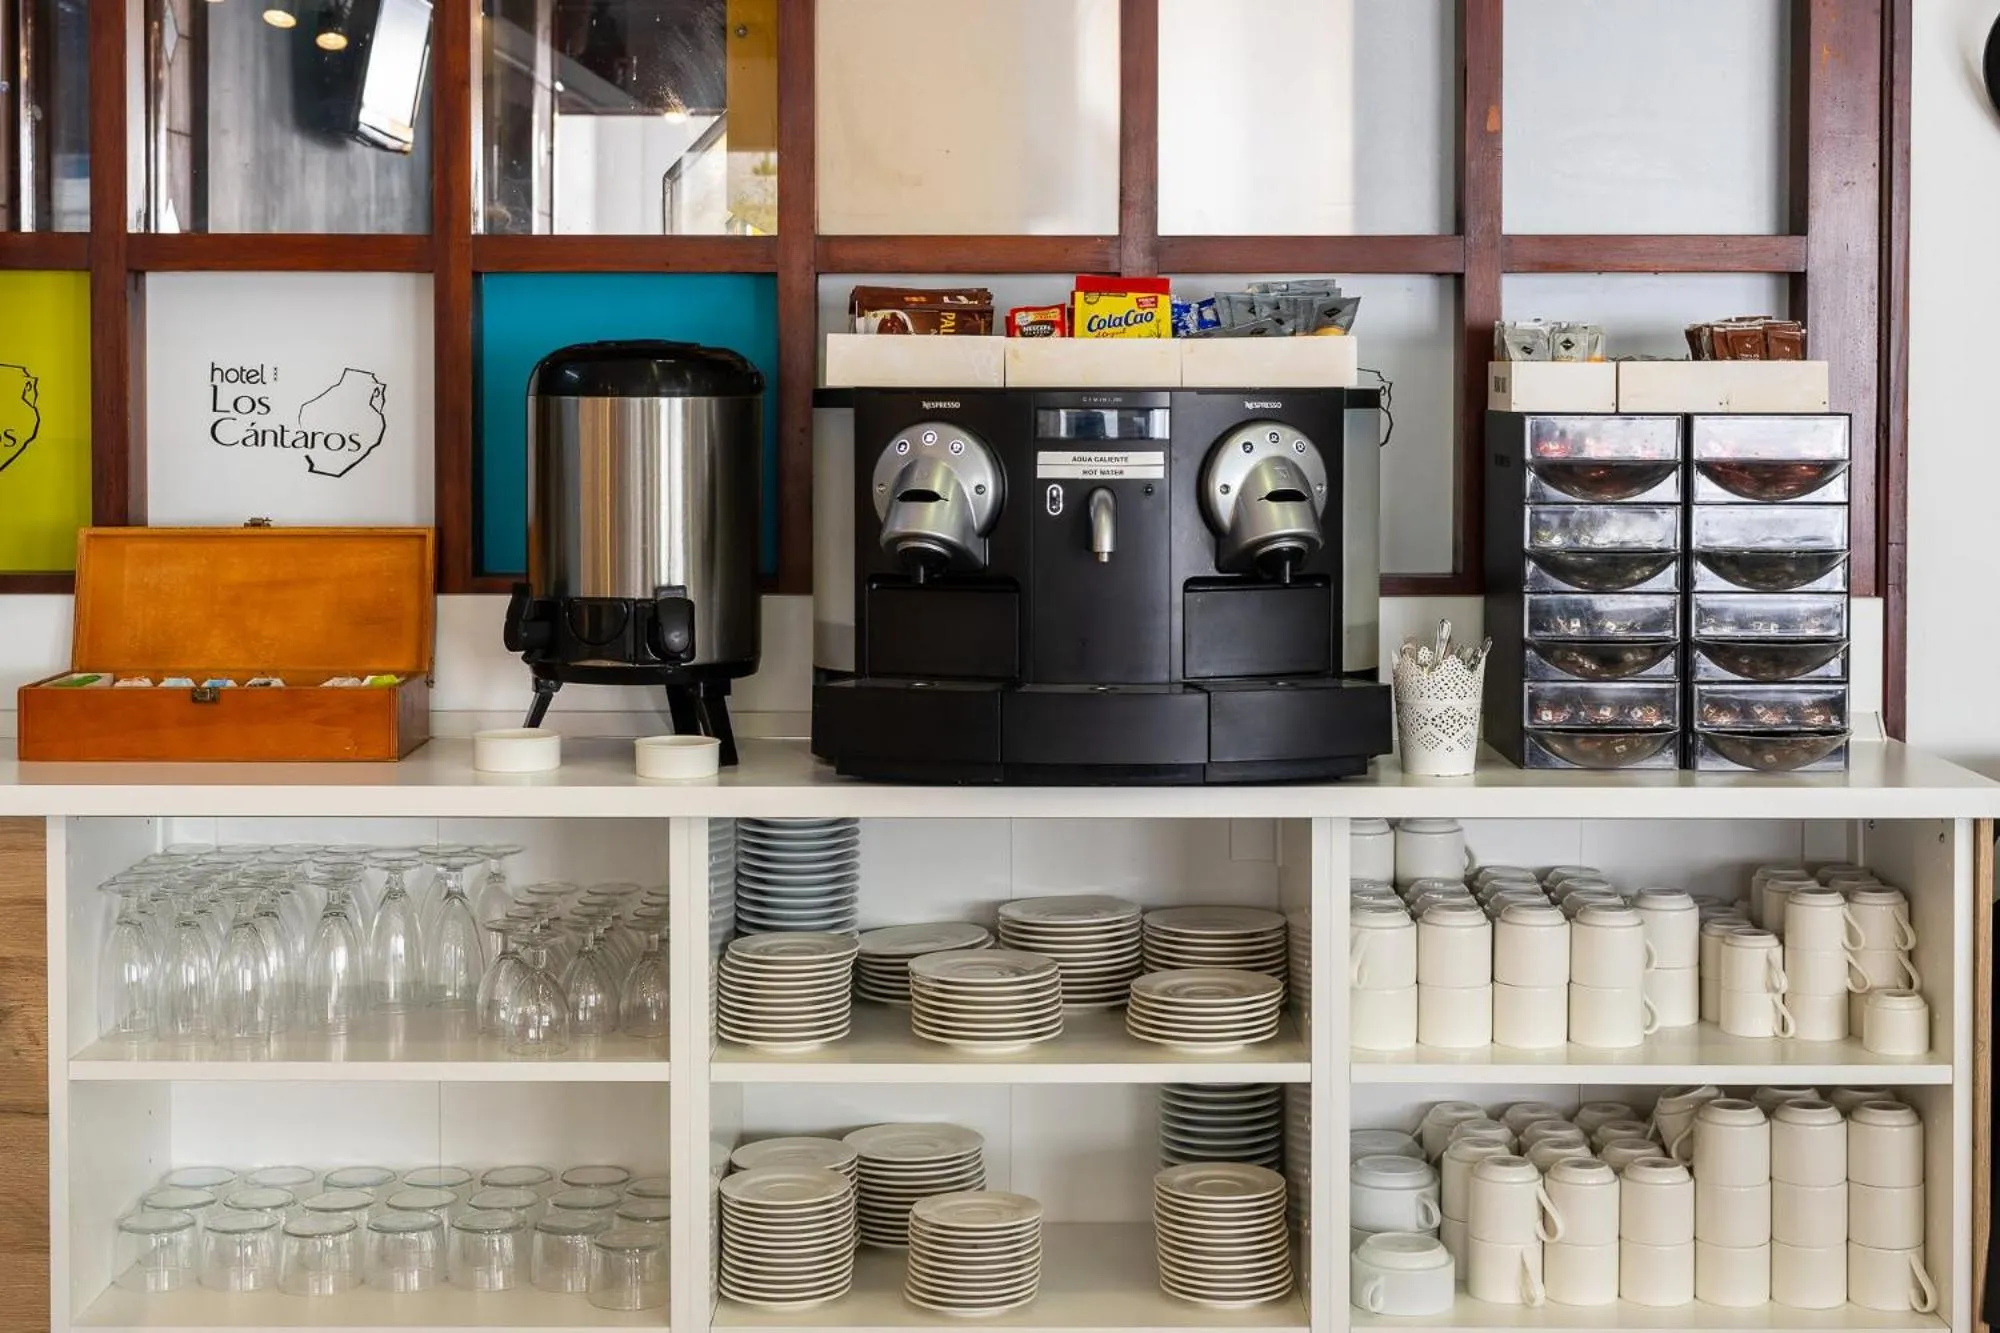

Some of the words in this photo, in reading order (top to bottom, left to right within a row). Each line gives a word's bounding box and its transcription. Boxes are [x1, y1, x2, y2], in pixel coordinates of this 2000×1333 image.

[1087, 309, 1155, 333] ColaCao
[210, 361, 267, 385] hotel
[211, 384, 272, 416] Los
[210, 416, 362, 452] Cántaros
